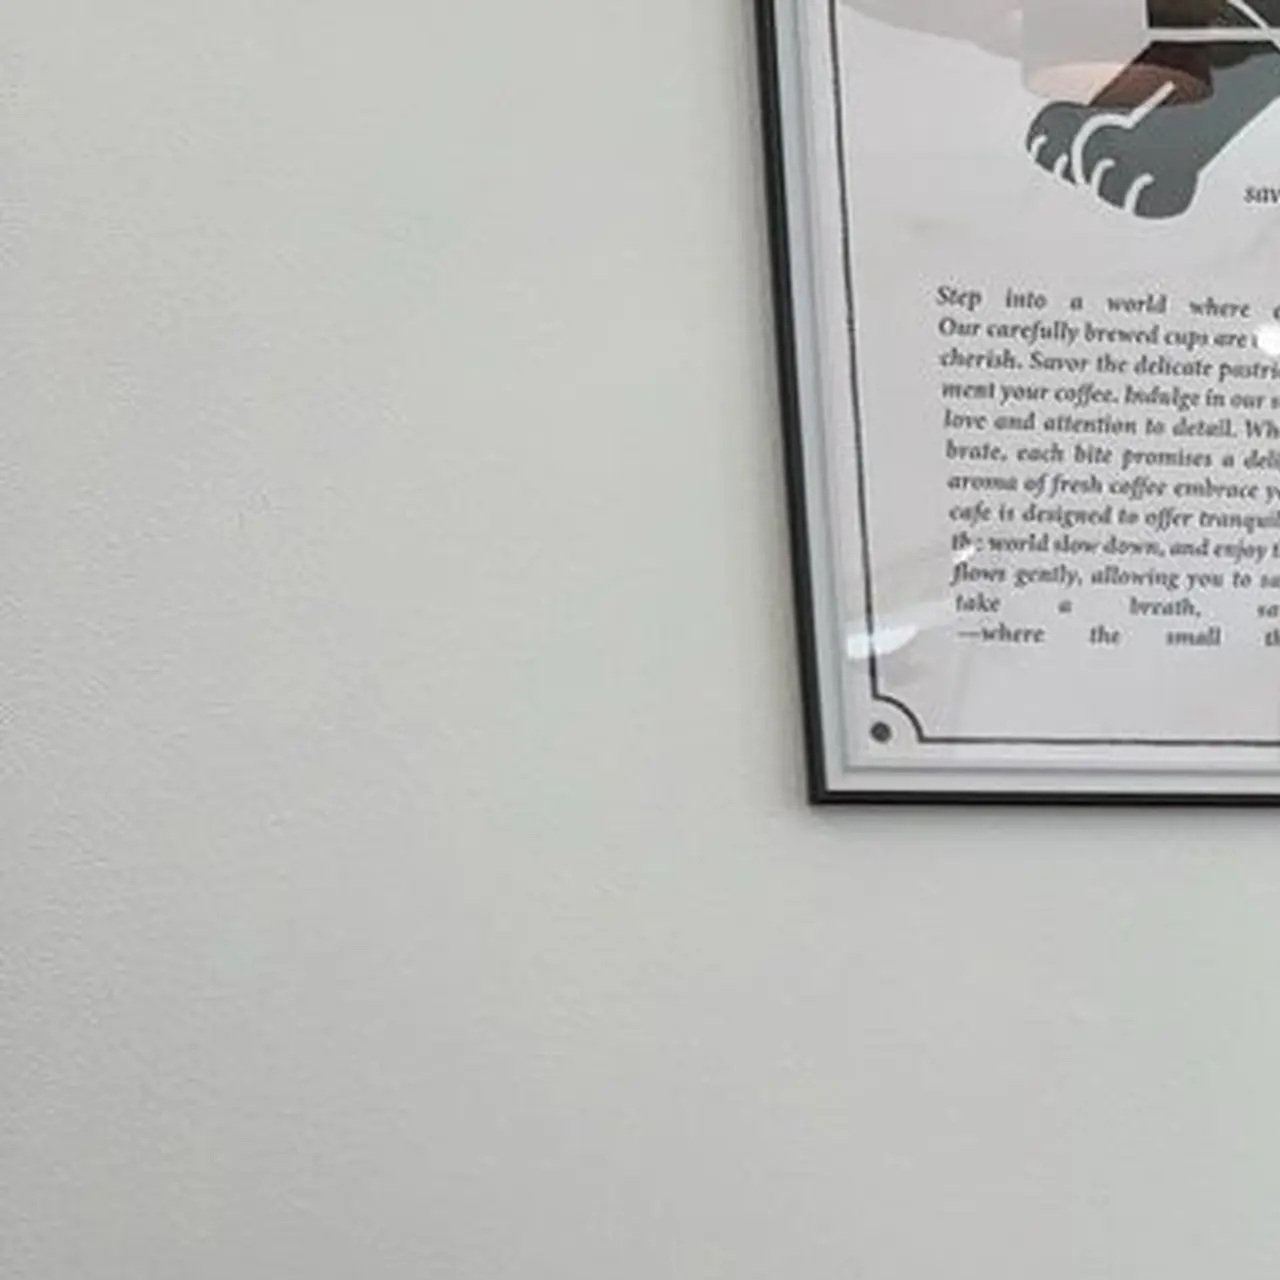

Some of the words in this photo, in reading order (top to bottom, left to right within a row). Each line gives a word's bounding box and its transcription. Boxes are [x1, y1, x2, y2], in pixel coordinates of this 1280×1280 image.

[936, 284, 982, 312] Step
[1006, 289, 1048, 309] into
[1070, 296, 1083, 311] a
[1108, 292, 1168, 314] world
[1190, 296, 1250, 318] where
[937, 314, 980, 336] Our
[987, 316, 1079, 346] carefully
[1084, 321, 1160, 344] brewed
[1164, 330, 1208, 351] cups
[1213, 332, 1247, 347] are
[939, 345, 1023, 368] cherish.
[1029, 349, 1089, 371] Savor
[1096, 352, 1127, 373] the
[1134, 353, 1213, 376] delicate
[941, 377, 995, 398] ment
[1001, 384, 1050, 405] your
[1054, 380, 1118, 408] coffee.
[1124, 383, 1200, 411] Indulge
[1206, 388, 1225, 406] in
[1230, 393, 1267, 408] our
[943, 407, 987, 428] love
[995, 409, 1035, 430] and
[1044, 412, 1136, 433] attention
[1145, 416, 1165, 434] to
[1173, 415, 1237, 437] detail.
[945, 438, 1008, 462] brate,
[1017, 440, 1064, 462] each
[1074, 442, 1110, 463] bite
[1121, 446, 1212, 472] promises
[1222, 453, 1234, 467] a
[947, 475, 1017, 491] aroma
[1024, 471, 1047, 497] of
[1046, 472, 1102, 499] fresh
[1109, 474, 1168, 501] coffee
[1173, 476, 1257, 498] embrace
[948, 499, 992, 526] cafe
[1001, 503, 1015, 521] is
[1022, 501, 1112, 529] designed
[1118, 506, 1139, 524] to
[1144, 505, 1191, 531] offer
[989, 531, 1049, 553] world
[1055, 533, 1098, 554] slow
[1103, 534, 1165, 558] down,
[1170, 536, 1208, 557] and
[1214, 543, 1269, 564] enjoy
[949, 561, 1005, 587] flows
[1013, 562, 1082, 589] gently,
[1091, 564, 1178, 591] allowing
[1187, 572, 1223, 592] you
[1232, 569, 1251, 588] to
[955, 592, 1001, 612] take
[1058, 600, 1072, 614] a
[1129, 596, 1201, 618] breath,
[1089, 624, 1120, 644] the
[1166, 626, 1221, 646] small
